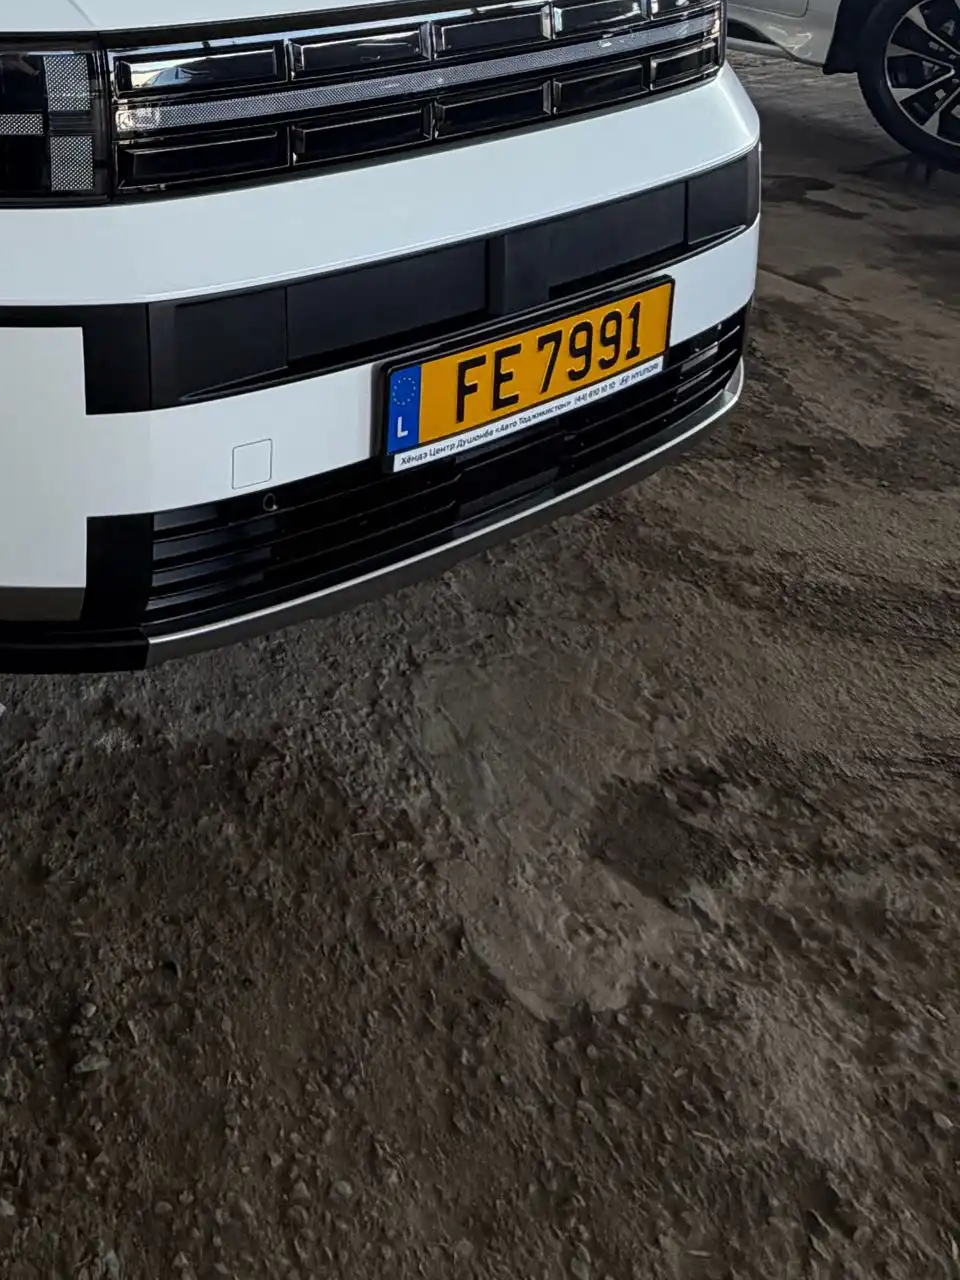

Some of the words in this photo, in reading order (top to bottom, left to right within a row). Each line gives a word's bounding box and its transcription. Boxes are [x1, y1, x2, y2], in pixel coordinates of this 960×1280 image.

[455, 343, 522, 424] FE
[537, 301, 641, 395] 7991
[397, 416, 408, 439] L
[429, 441, 456, 458] Центр
